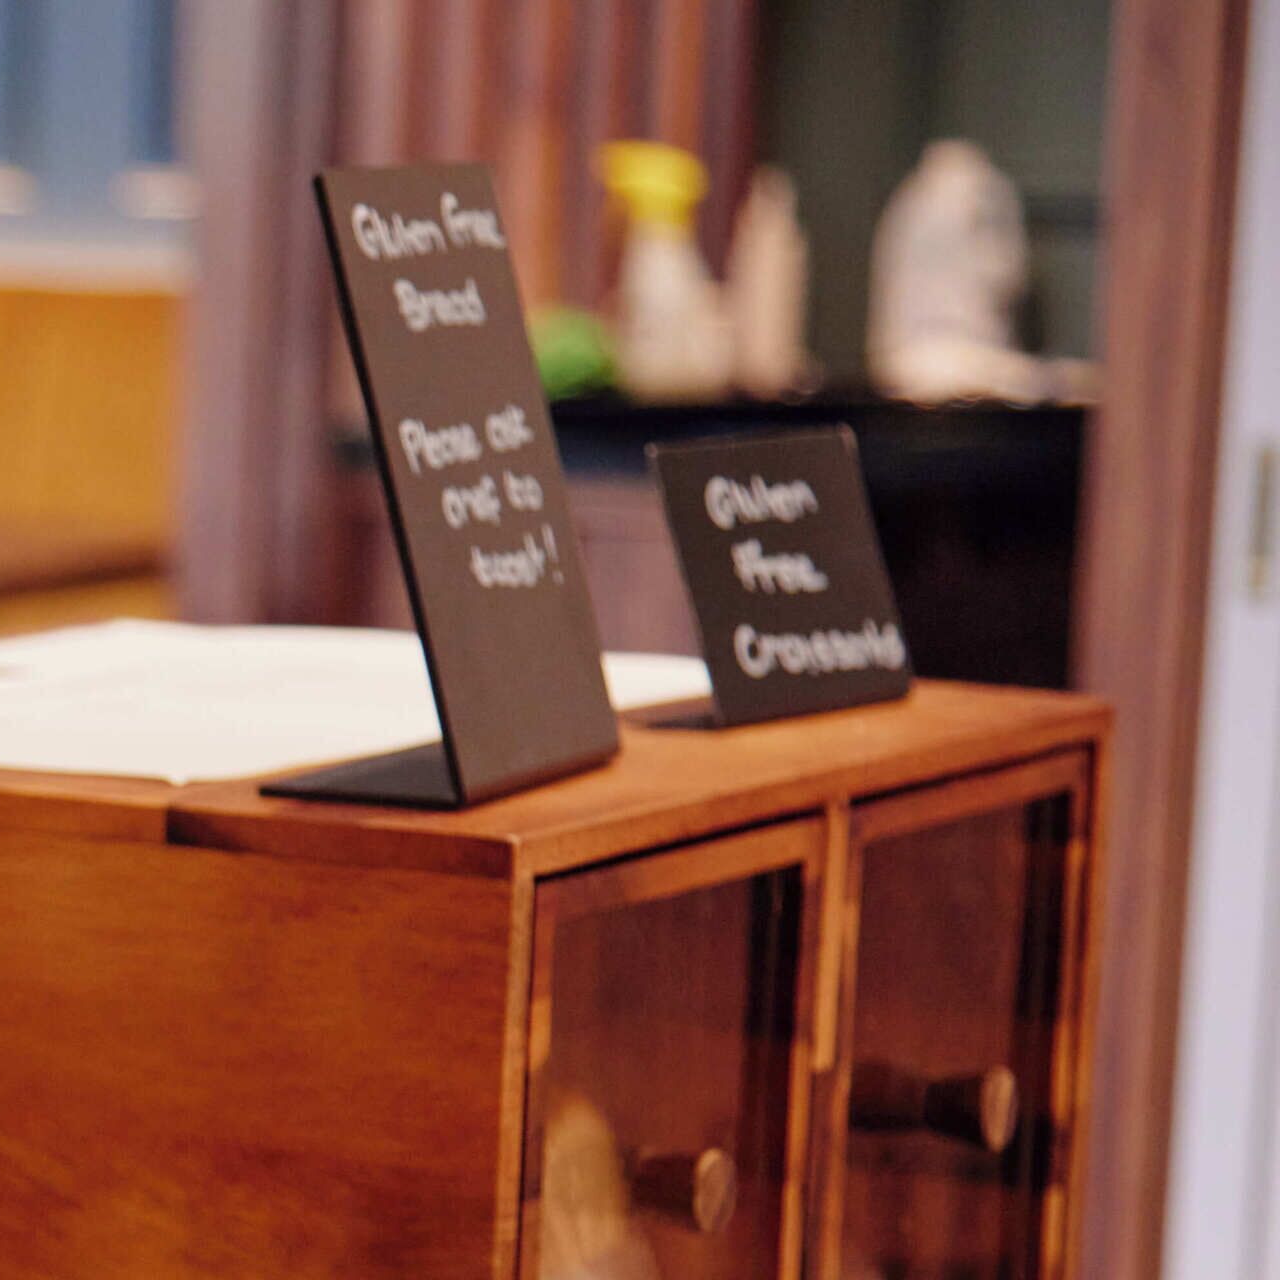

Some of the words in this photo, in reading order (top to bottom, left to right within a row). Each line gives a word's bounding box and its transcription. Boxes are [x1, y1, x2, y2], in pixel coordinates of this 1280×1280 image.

[351, 202, 448, 260] Gluten
[393, 276, 488, 333] Bread
[502, 469, 545, 512] to
[704, 474, 820, 531] Gluten
